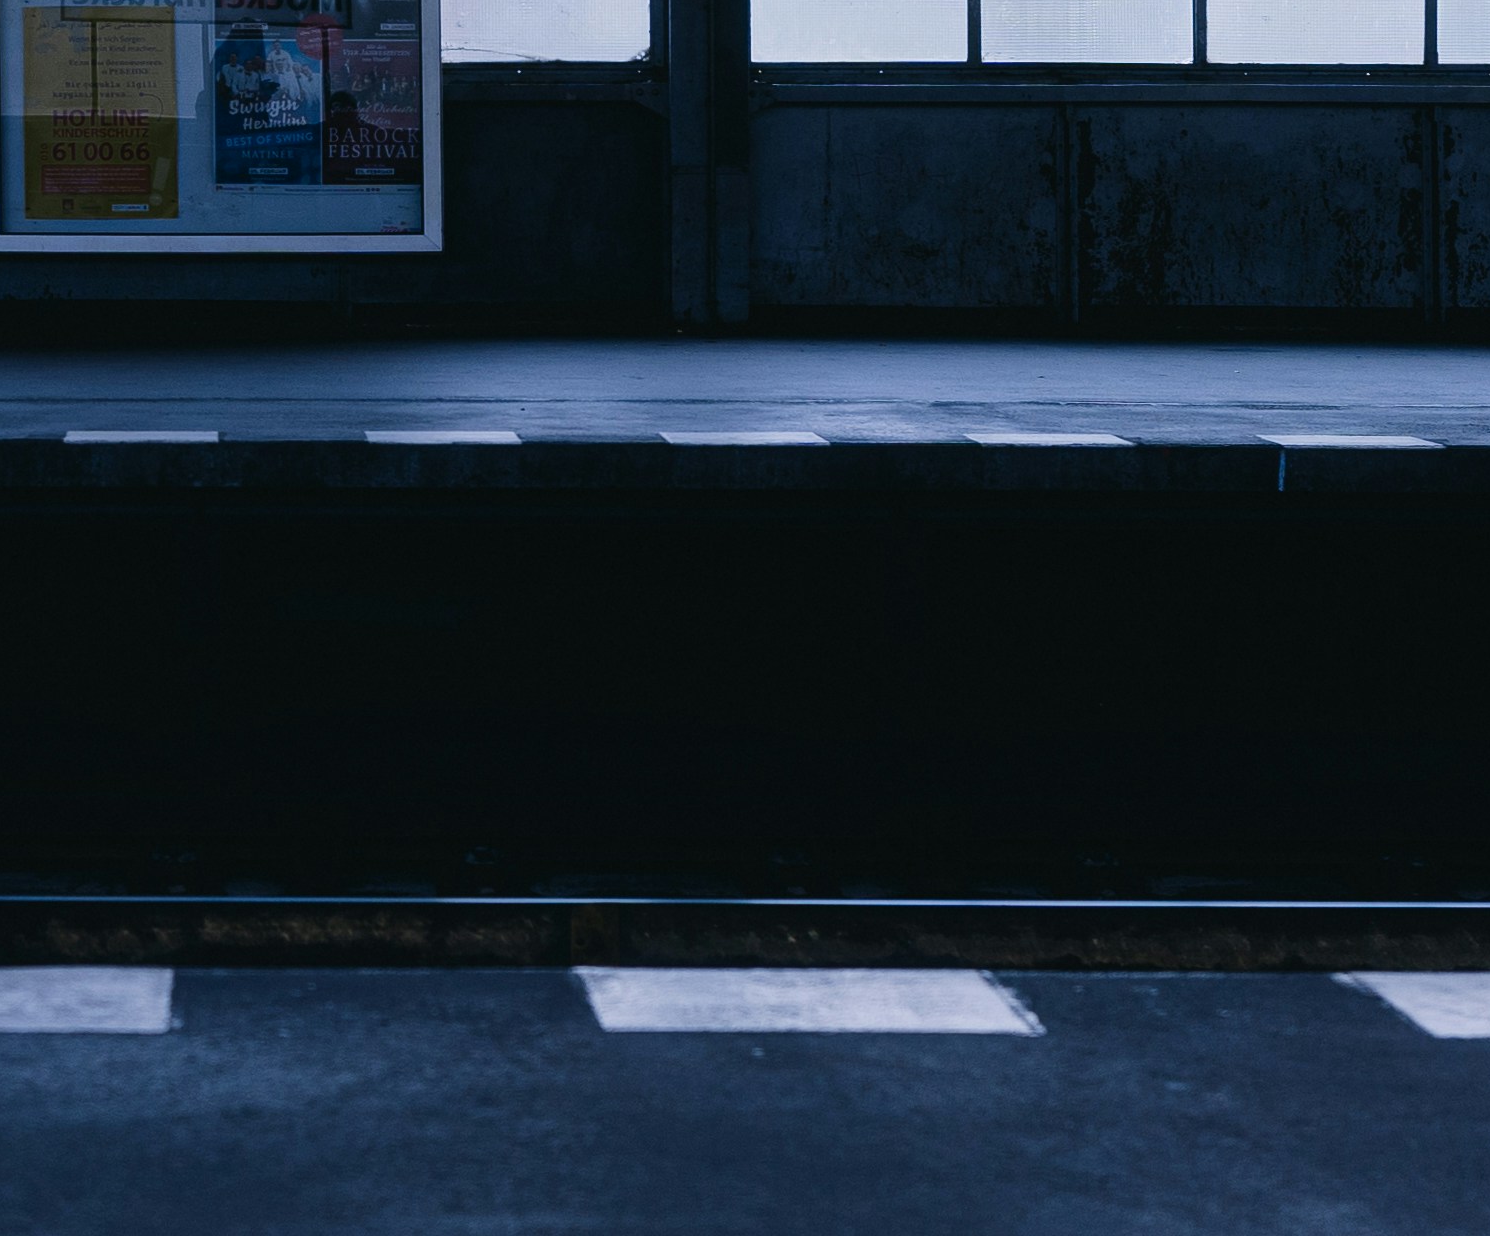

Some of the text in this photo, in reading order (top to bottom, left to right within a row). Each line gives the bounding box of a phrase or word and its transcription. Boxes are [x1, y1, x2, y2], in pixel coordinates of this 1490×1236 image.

[52, 109, 150, 127] HOTLINE
[242, 114, 308, 130] Hermlins
[52, 127, 149, 138] KINDERSCHUTZ
[226, 132, 314, 148] BEST OF SWING
[329, 127, 419, 144] BAROCK
[52, 142, 150, 161] 61 00 66
[328, 144, 419, 159] FESTIVAL
